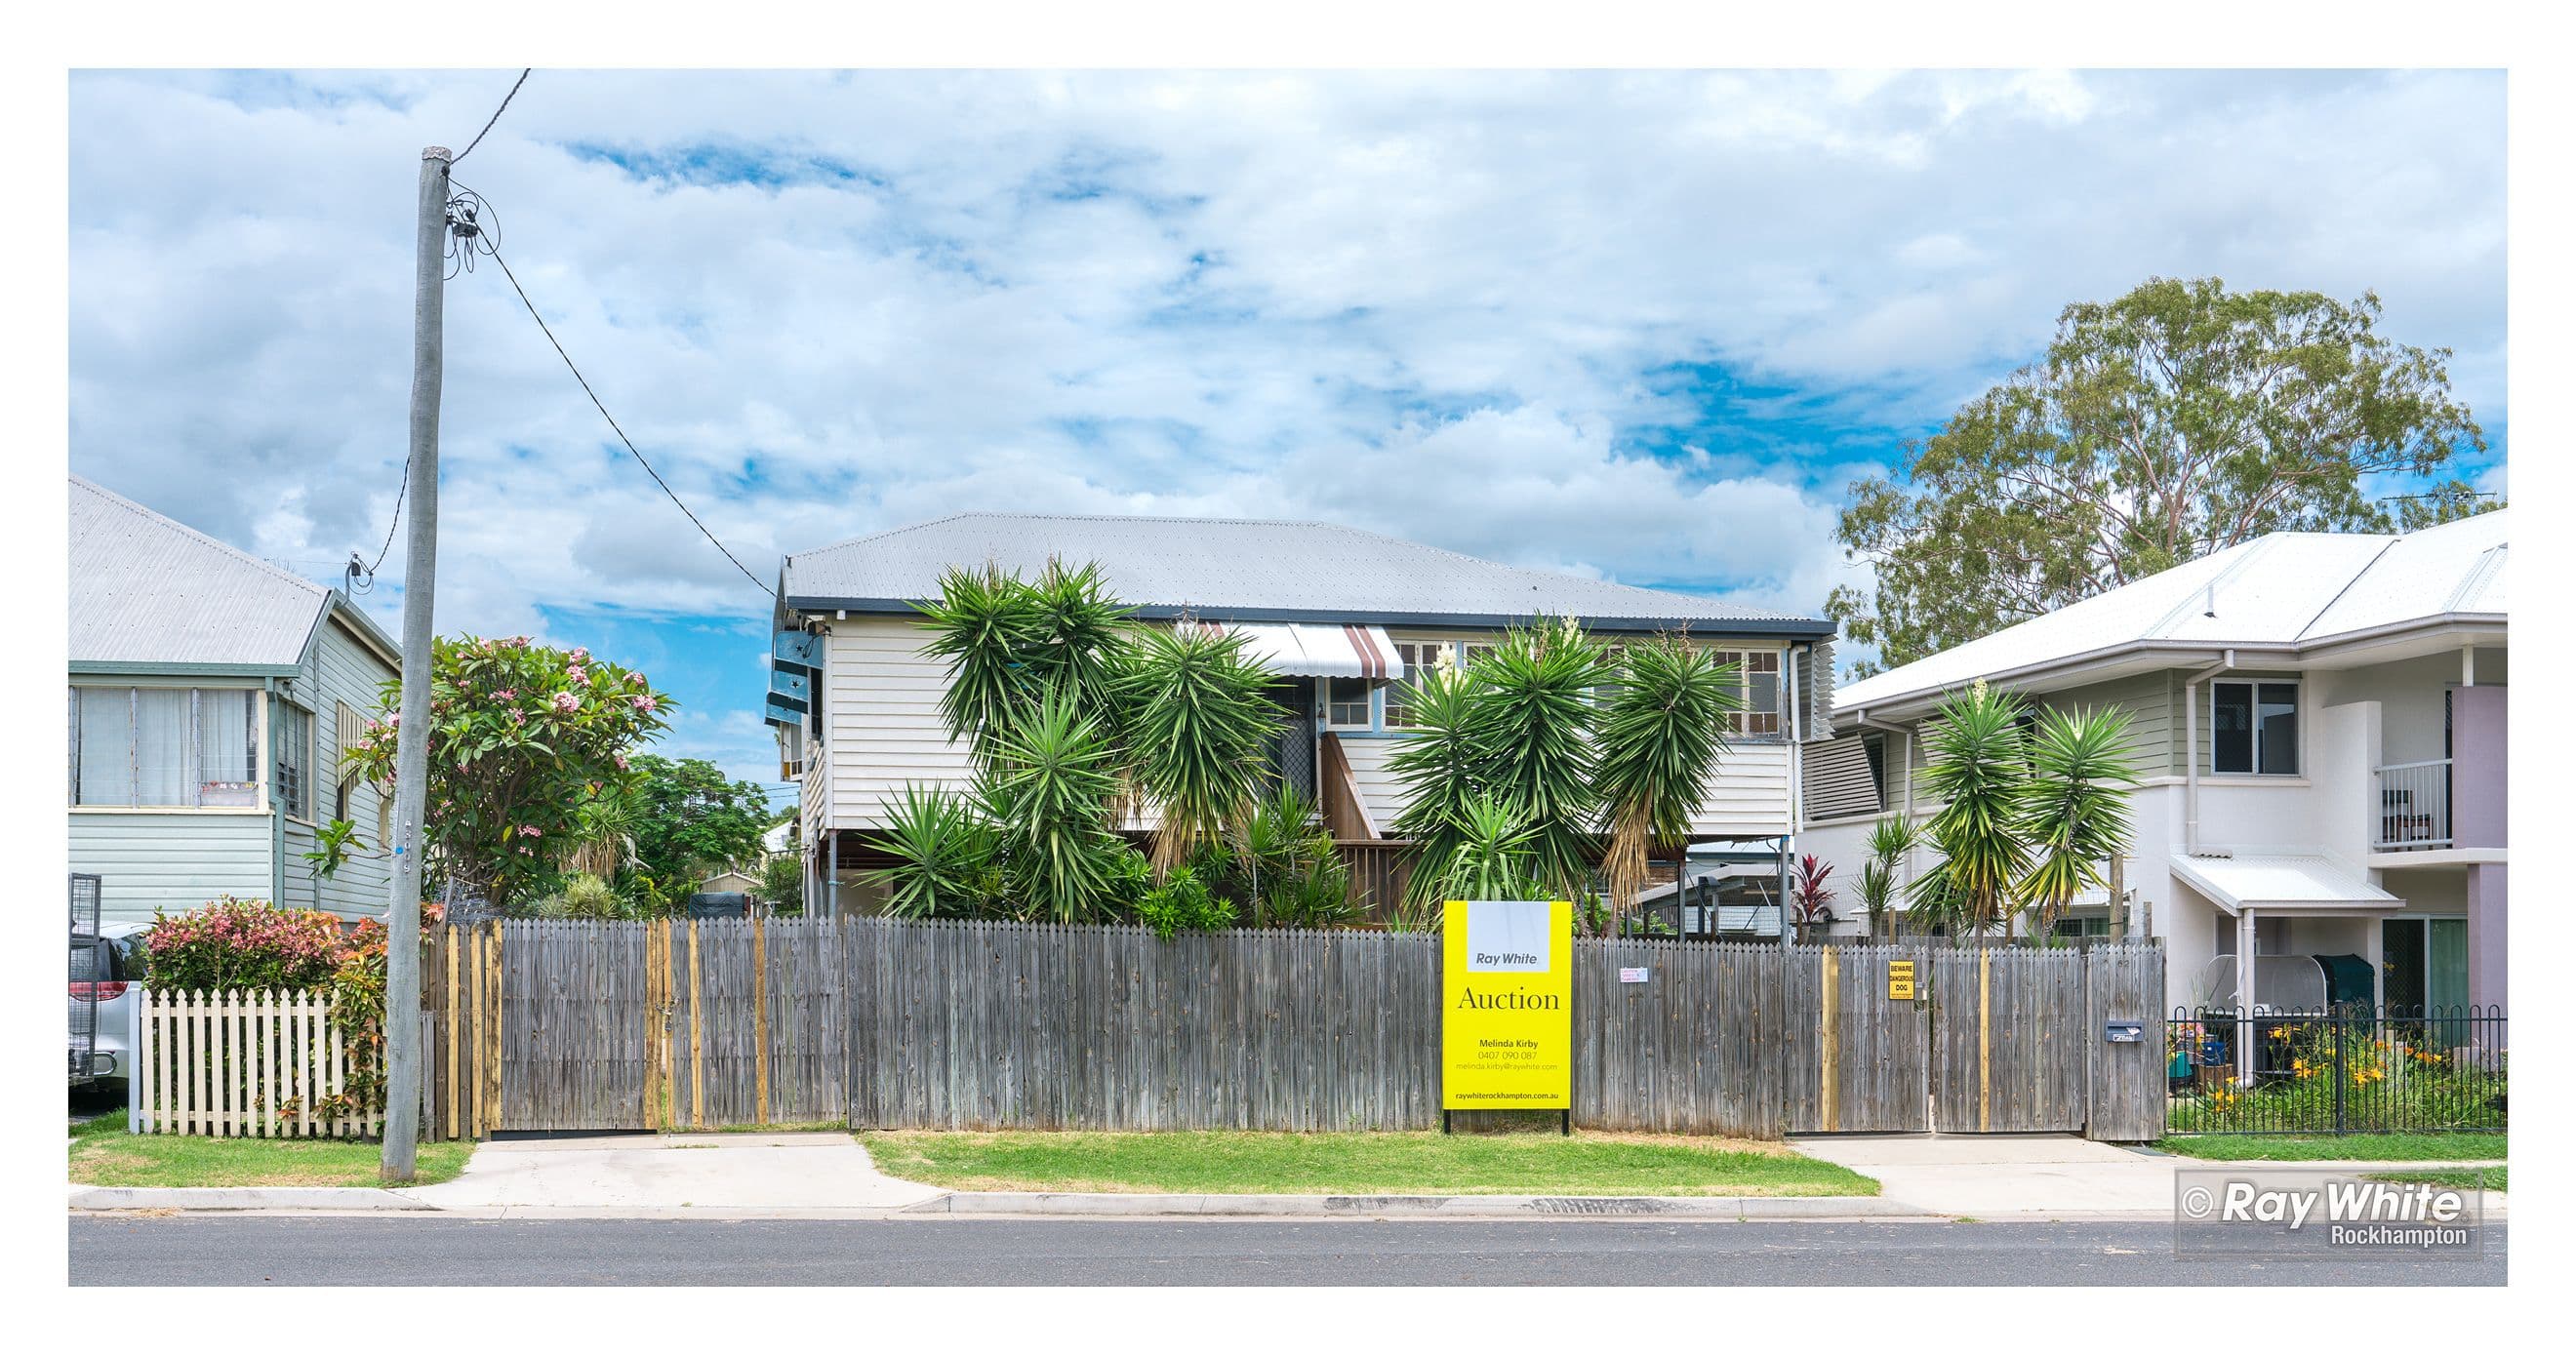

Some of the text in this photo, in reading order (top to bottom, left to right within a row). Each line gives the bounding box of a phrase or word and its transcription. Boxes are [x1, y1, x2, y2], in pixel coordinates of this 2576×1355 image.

[1475, 952, 1538, 966] Ray White
[1457, 986, 1560, 1010] Auction
[1479, 1039, 1539, 1050] Melinda Kirby
[1477, 1051, 1538, 1059] 0407 090 087
[1456, 1062, 1558, 1072] melinda.kirby@raywhite.com
[1455, 1092, 1559, 1100] raywhiterockhampton.com.au
